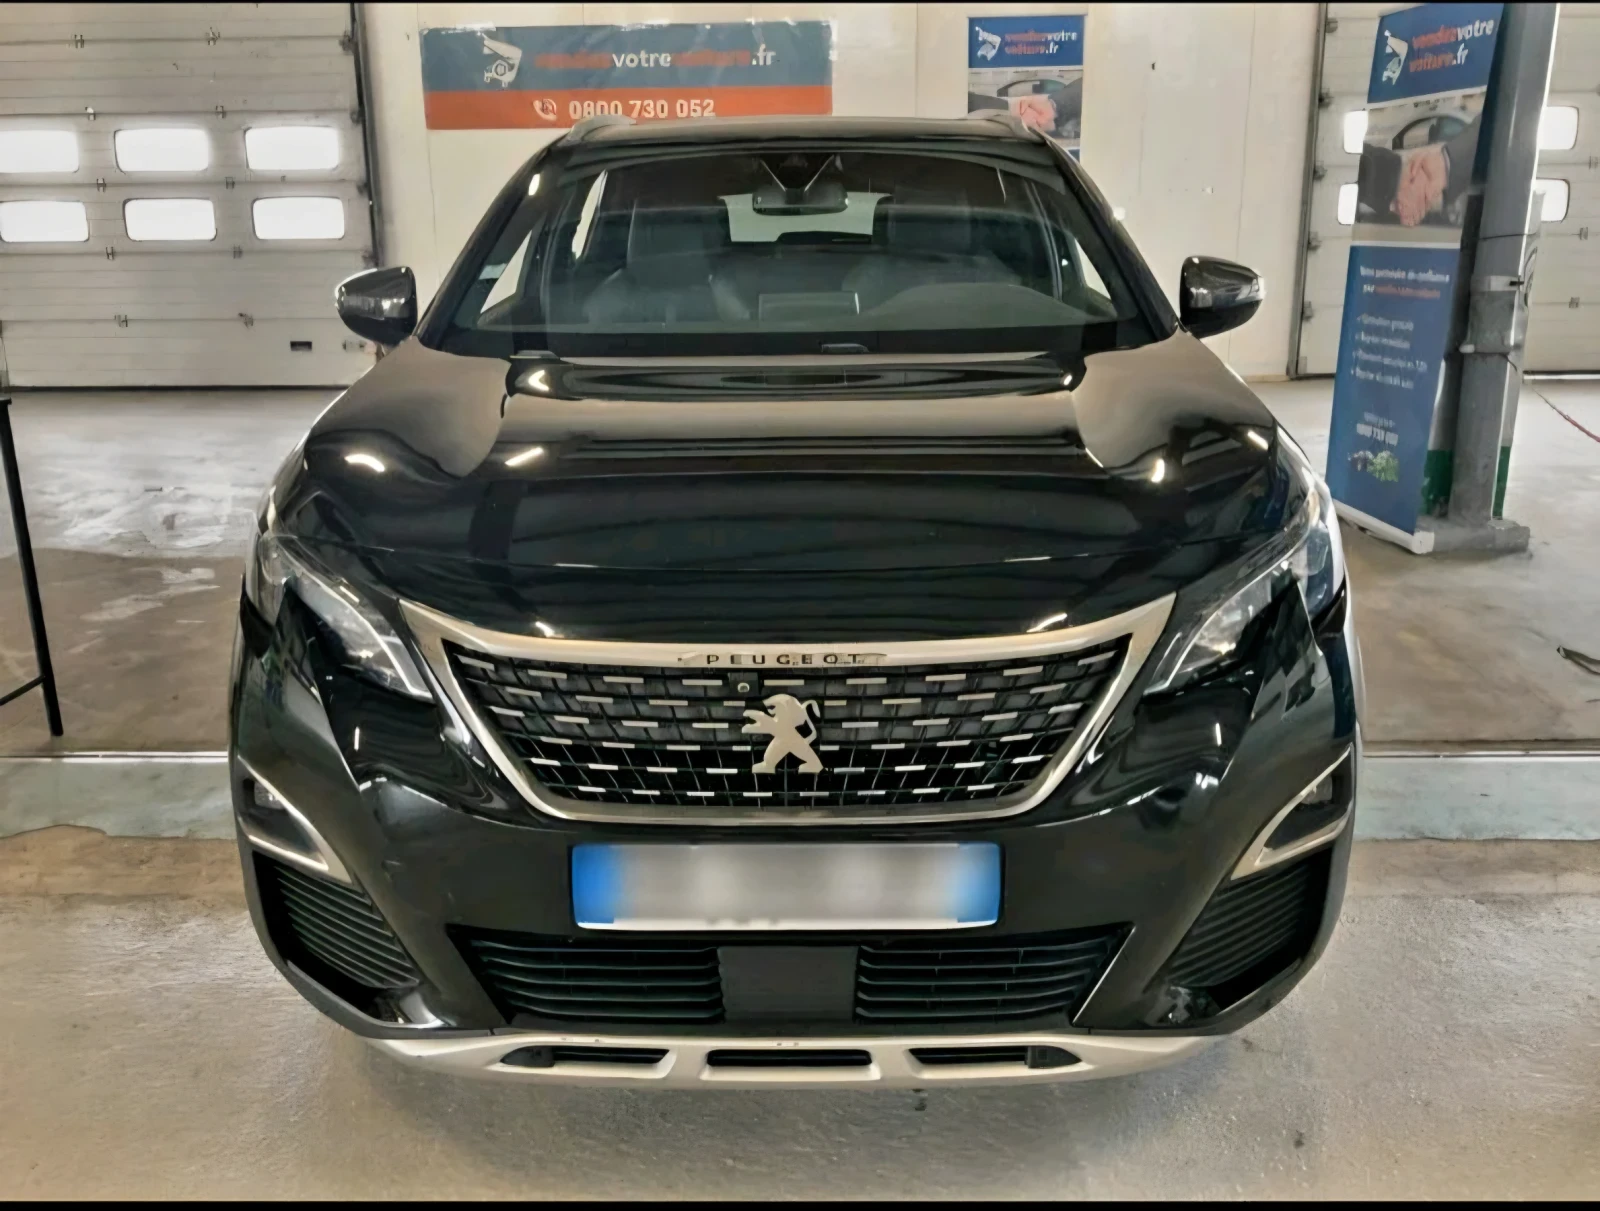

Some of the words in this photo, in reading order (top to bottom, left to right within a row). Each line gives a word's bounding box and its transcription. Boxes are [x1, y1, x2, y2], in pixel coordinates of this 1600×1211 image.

[568, 99, 623, 120] 0800
[628, 99, 669, 119] 730
[676, 98, 716, 118] 052
[706, 653, 860, 665] PEUGEOT
